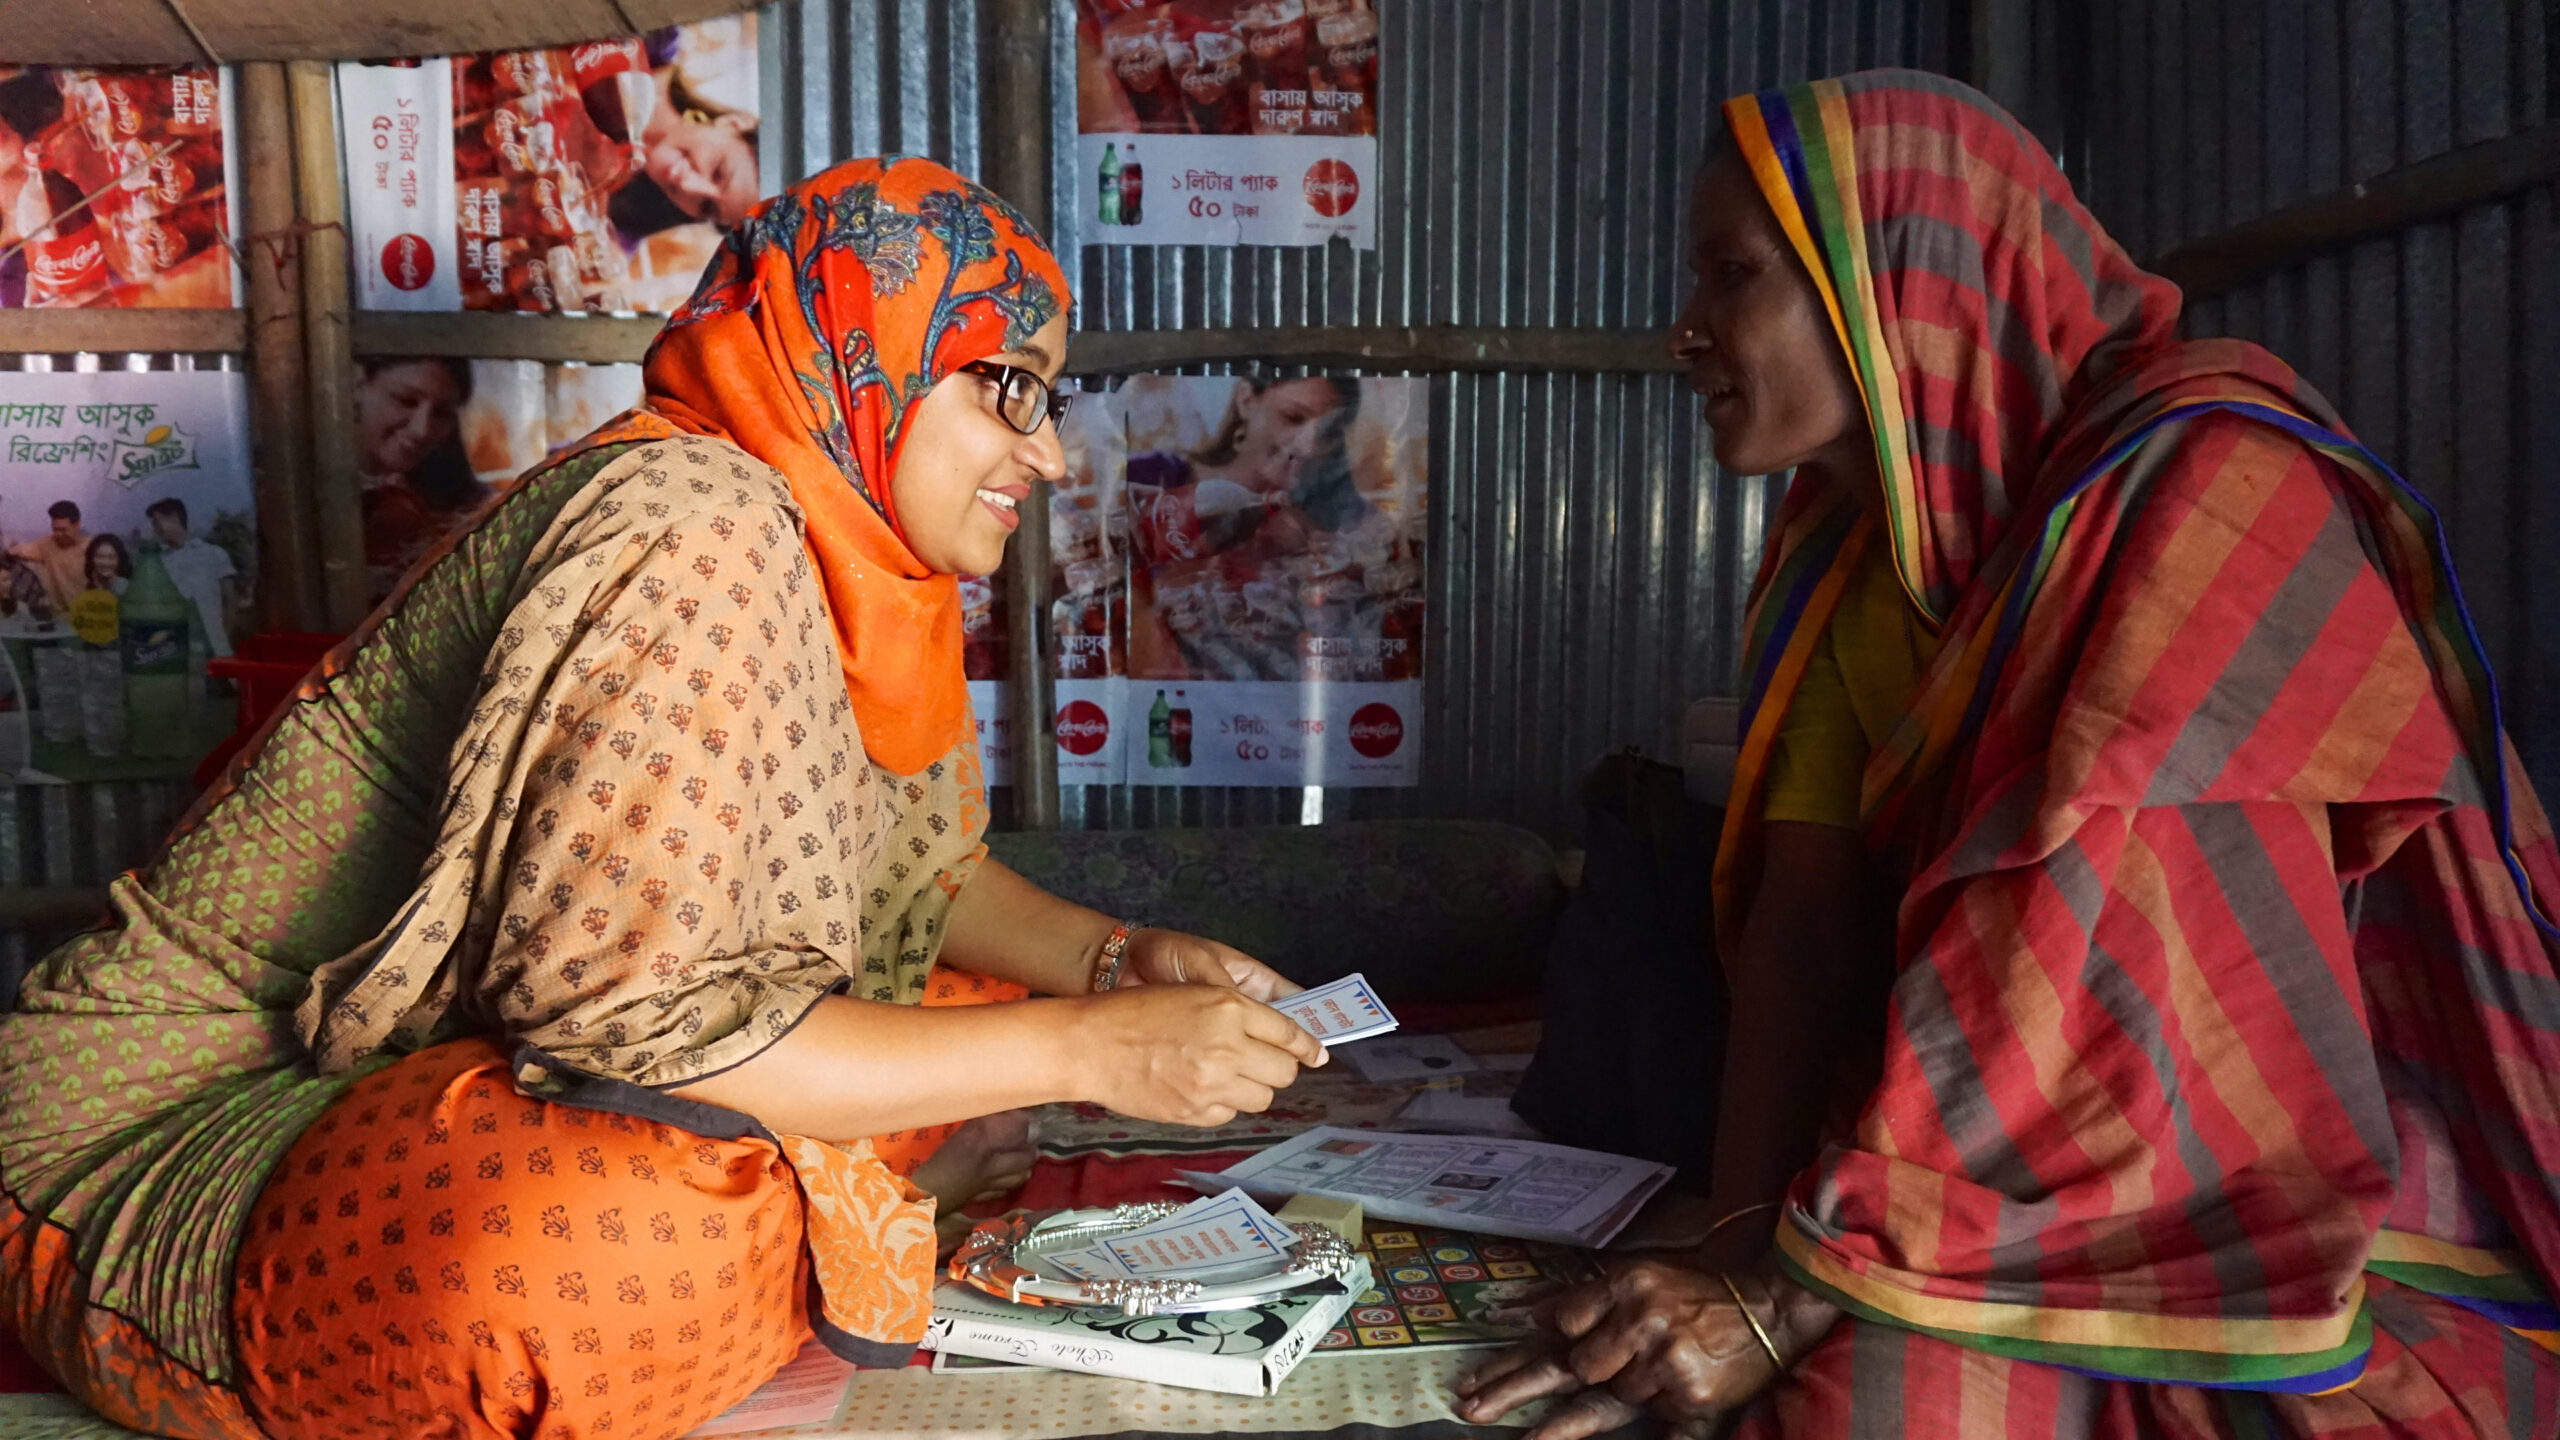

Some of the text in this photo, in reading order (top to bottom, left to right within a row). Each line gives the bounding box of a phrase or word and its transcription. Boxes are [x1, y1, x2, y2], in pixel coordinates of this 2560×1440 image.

[172, 75, 192, 124] বাসায়
[193, 79, 212, 125] দারুণ
[1260, 89, 1363, 112] বাসায় আসুক
[1259, 109, 1339, 126] দারুণ স্বাদ
[372, 115, 393, 190] ৫০ টাকা
[397, 113, 421, 162] লিটার
[399, 169, 418, 209] প্যাক
[1185, 169, 1233, 192] লিটার
[1240, 173, 1279, 192] প্যাক
[1188, 196, 1260, 218] ৫০ টাকা
[462, 188, 483, 269] দারুণ স্বাদ
[480, 188, 504, 293] বাসায় আসুক
[0, 402, 158, 436] াসায় আসুক
[9, 434, 110, 464] রিফ্রেশিং
[1236, 740, 1269, 761] ৫০
[968, 1331, 1113, 1366] Photo Frame
